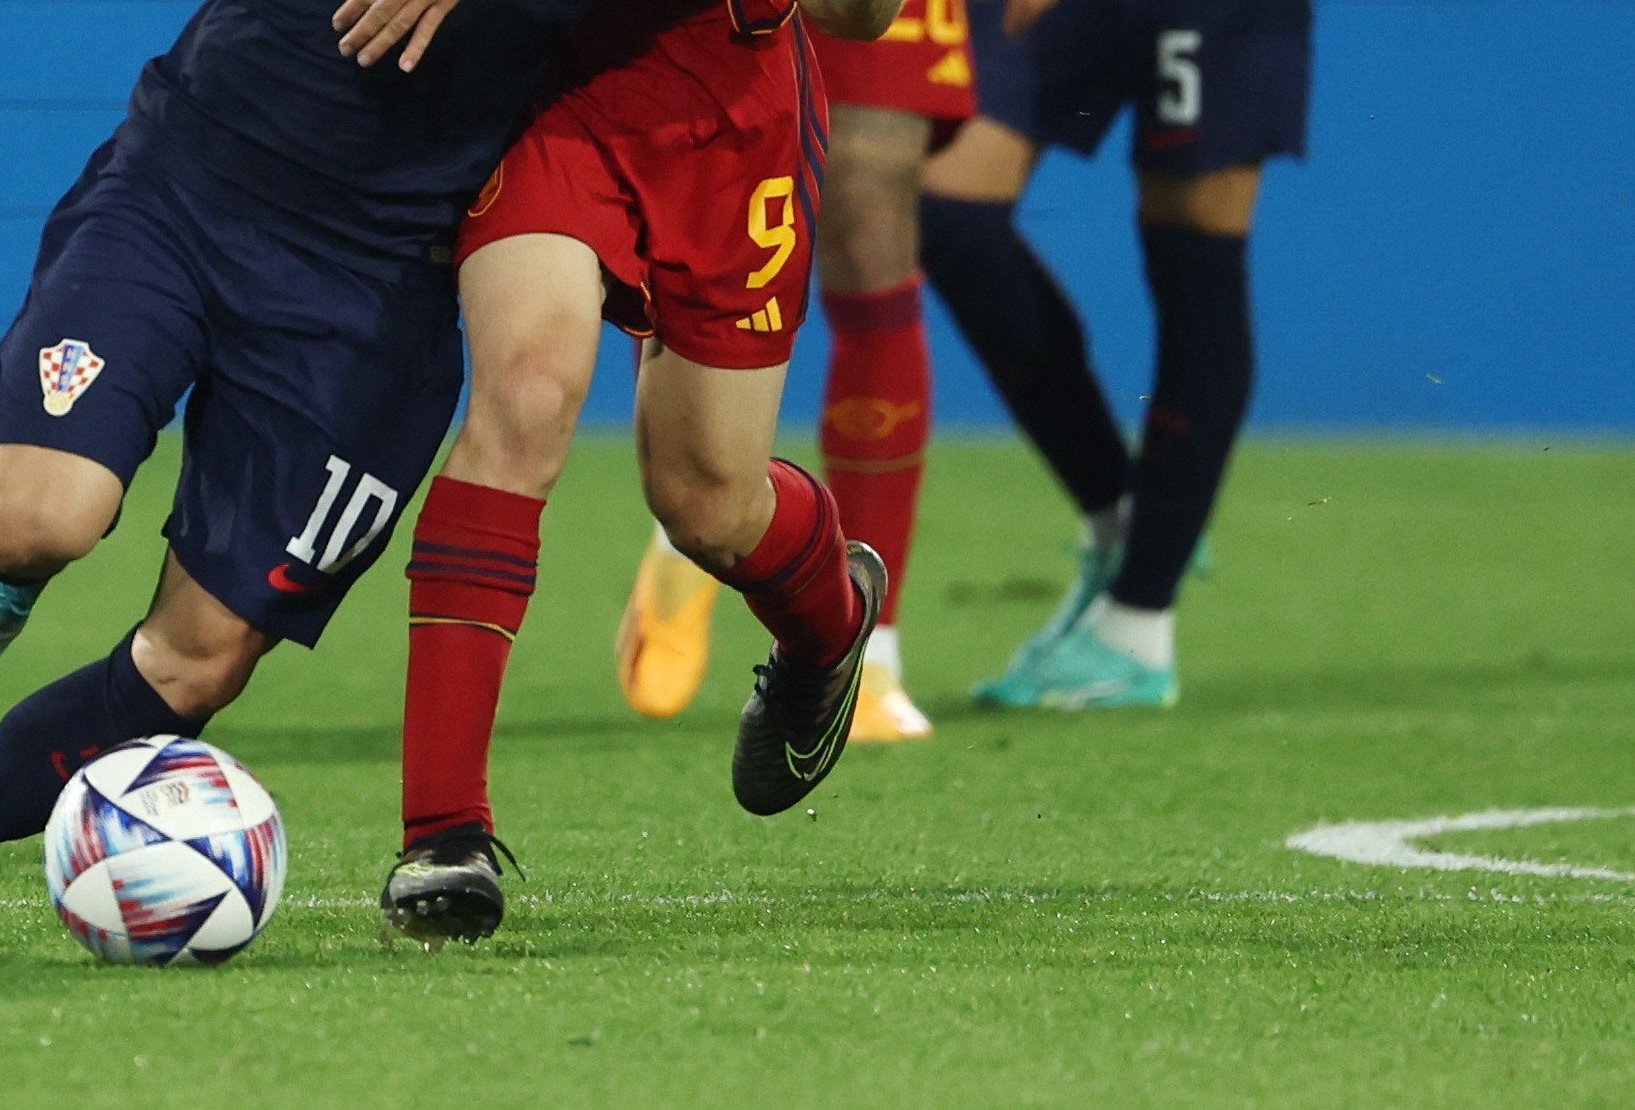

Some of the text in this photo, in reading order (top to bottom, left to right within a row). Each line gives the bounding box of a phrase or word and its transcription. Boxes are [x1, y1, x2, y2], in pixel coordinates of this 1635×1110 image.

[1157, 29, 1203, 126] 5
[745, 175, 796, 289] 9
[285, 454, 398, 574] 10
